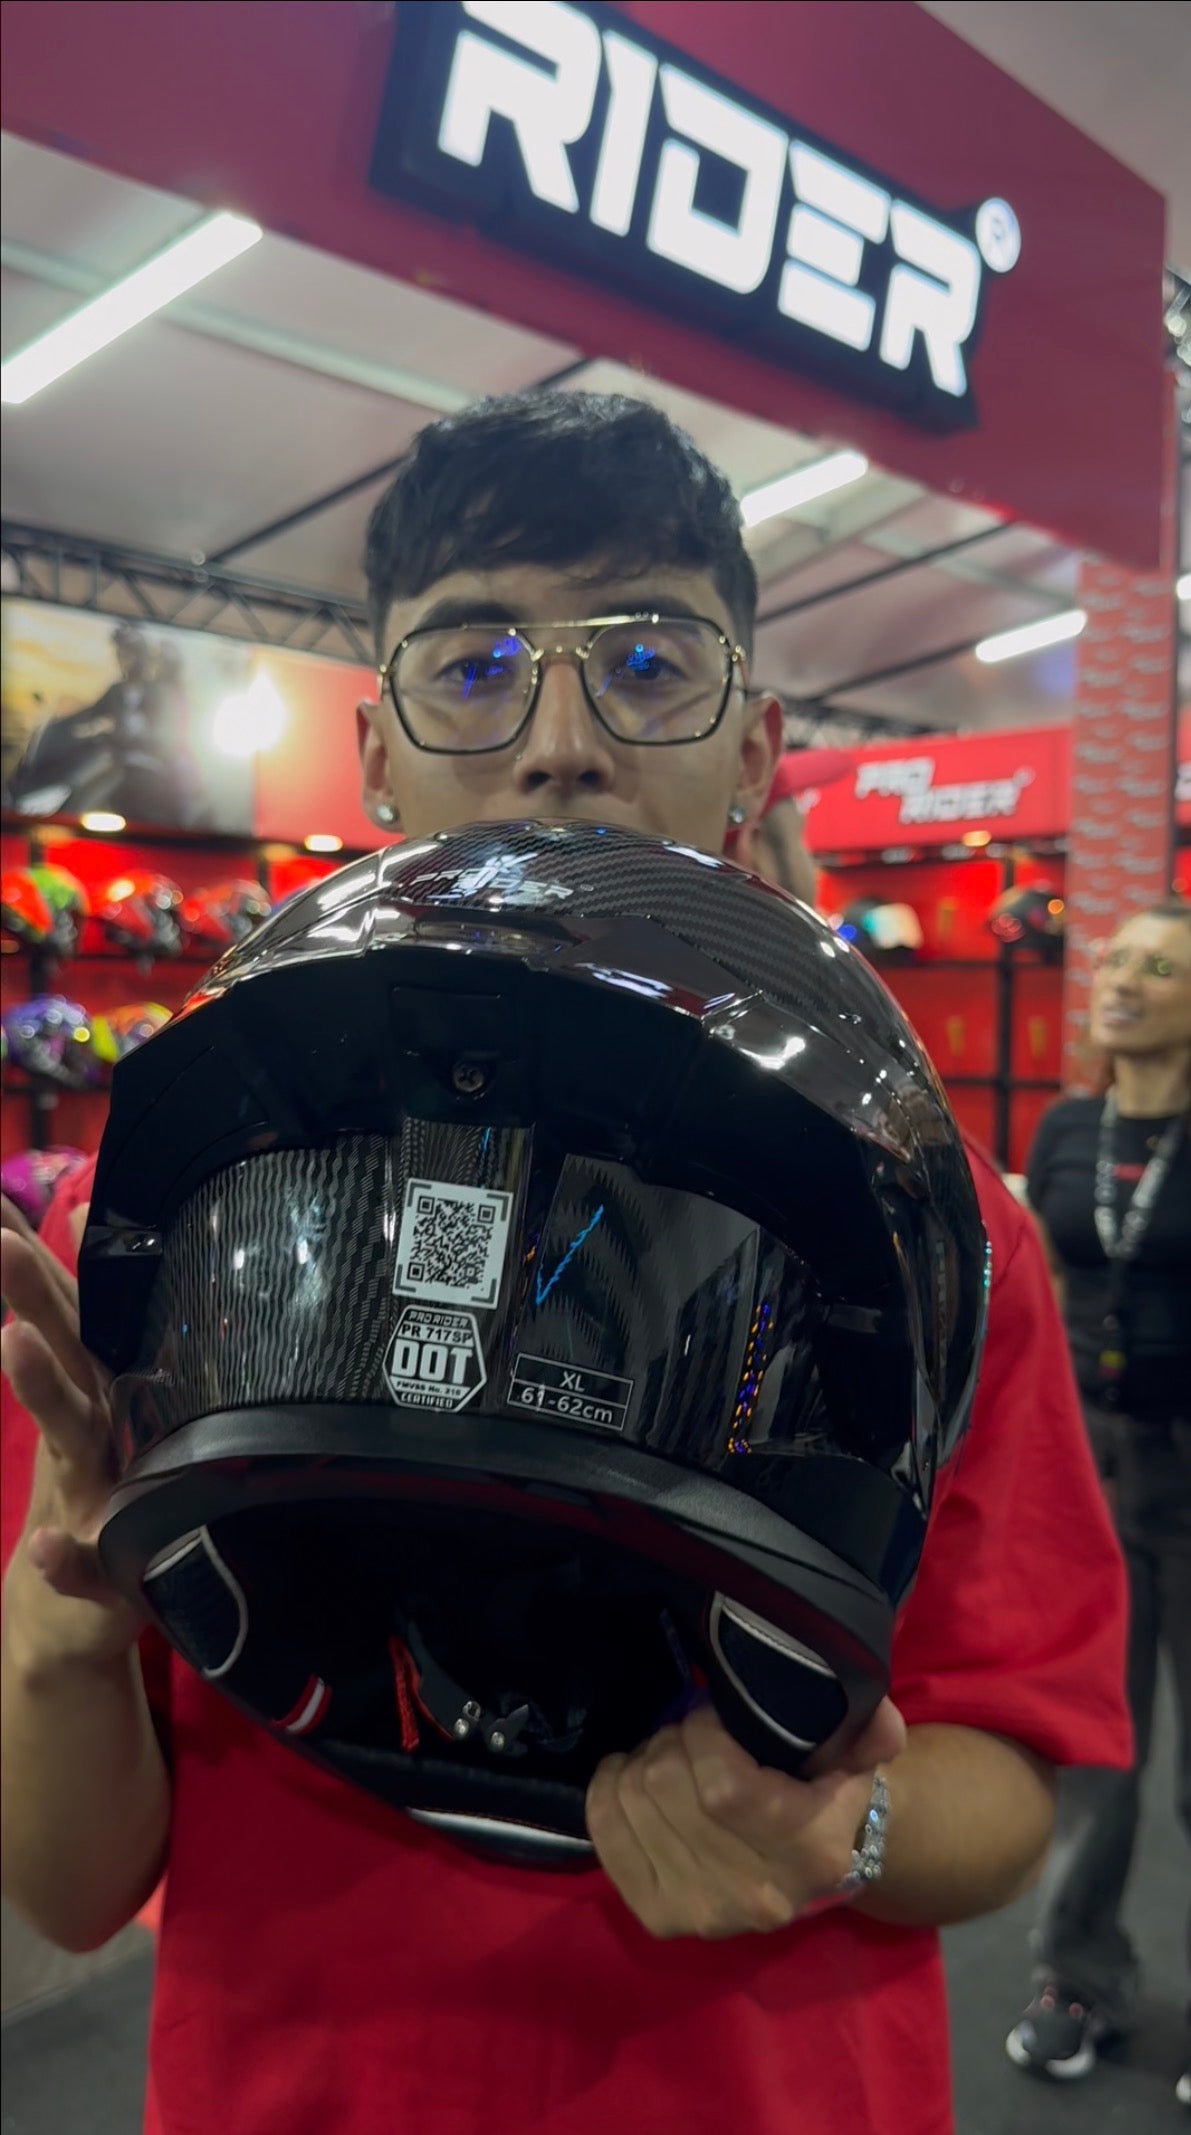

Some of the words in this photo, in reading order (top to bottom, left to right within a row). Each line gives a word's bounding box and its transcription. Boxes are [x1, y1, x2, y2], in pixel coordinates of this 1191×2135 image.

[855, 756, 935, 799] PRO
[401, 1323, 421, 1338] PR
[426, 1326, 472, 1344] 717SP
[391, 1338, 473, 1385] DOT
[560, 1371, 585, 1393] XL
[400, 1392, 454, 1409] CERTIFIED
[521, 1386, 613, 1424] 61-62cm
